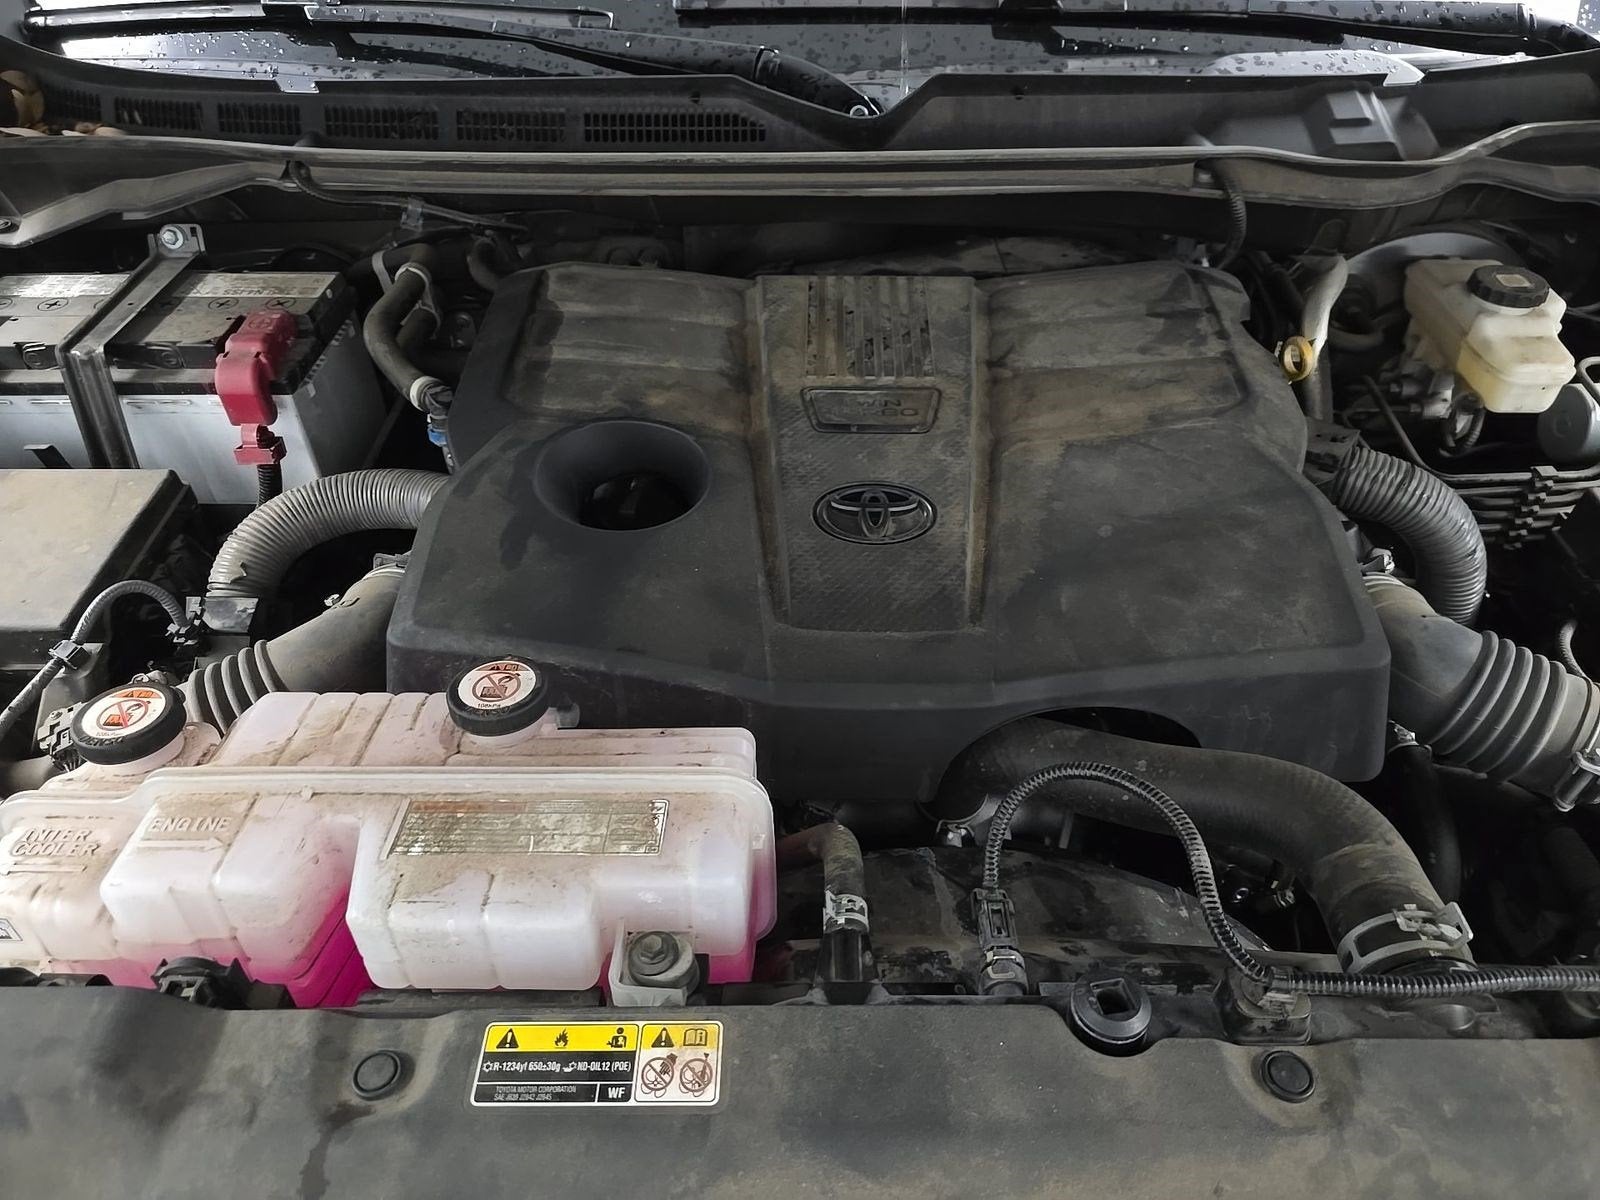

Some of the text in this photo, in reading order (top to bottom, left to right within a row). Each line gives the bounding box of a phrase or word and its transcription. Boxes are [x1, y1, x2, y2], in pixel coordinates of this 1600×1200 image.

[148, 816, 233, 834] ENGINE
[21, 828, 93, 843] INTER
[11, 842, 101, 857] COOLER
[493, 1061, 527, 1073] R-1234yf
[608, 1086, 626, 1099] WF
